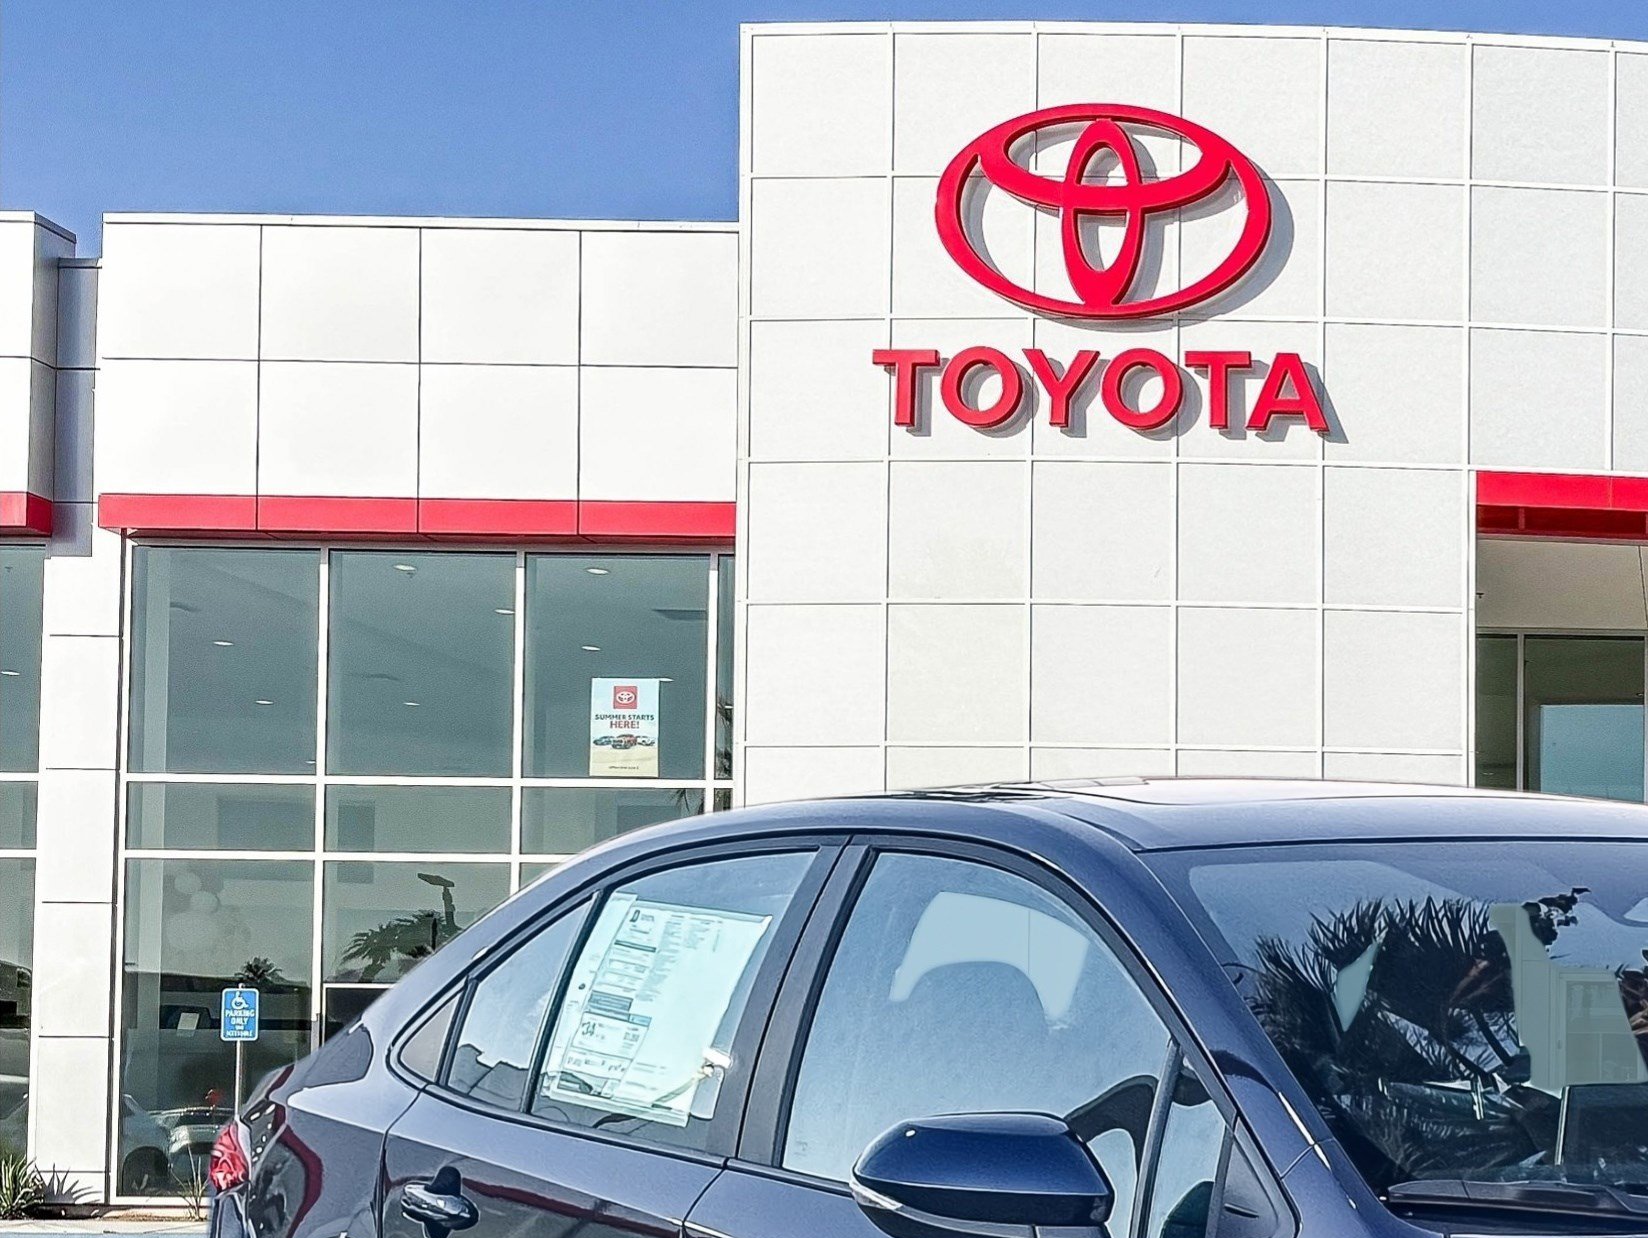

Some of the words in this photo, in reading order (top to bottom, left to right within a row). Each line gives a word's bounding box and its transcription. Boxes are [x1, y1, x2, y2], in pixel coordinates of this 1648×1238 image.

[873, 346, 1329, 432] TOYOTA
[609, 720, 640, 729] HERE!
[225, 1009, 255, 1017] PARKING
[231, 1017, 249, 1025] ONLY
